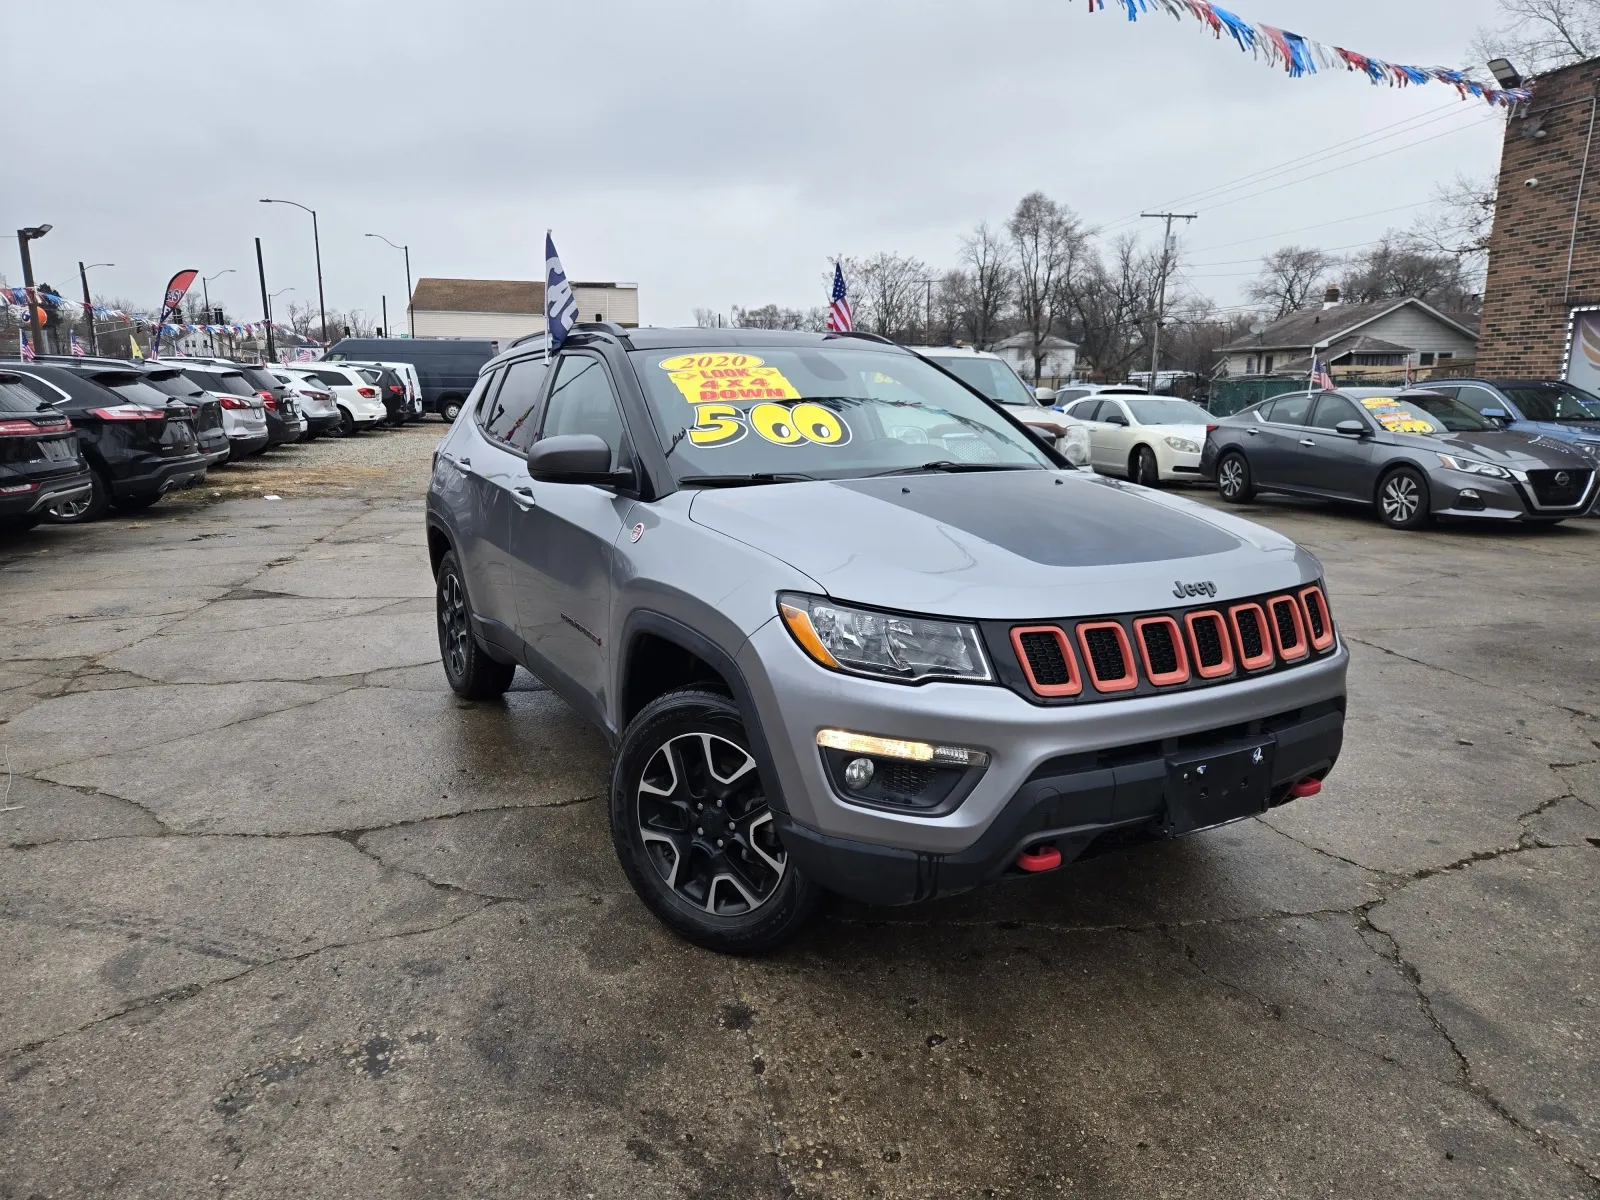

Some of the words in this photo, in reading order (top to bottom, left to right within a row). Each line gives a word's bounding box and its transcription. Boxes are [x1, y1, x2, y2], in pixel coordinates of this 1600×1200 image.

[679, 355, 747, 370] 2020
[700, 368, 751, 379] LOOK
[699, 388, 786, 400] DOWN
[686, 403, 852, 448] 500
[1172, 580, 1218, 599] Jeep
